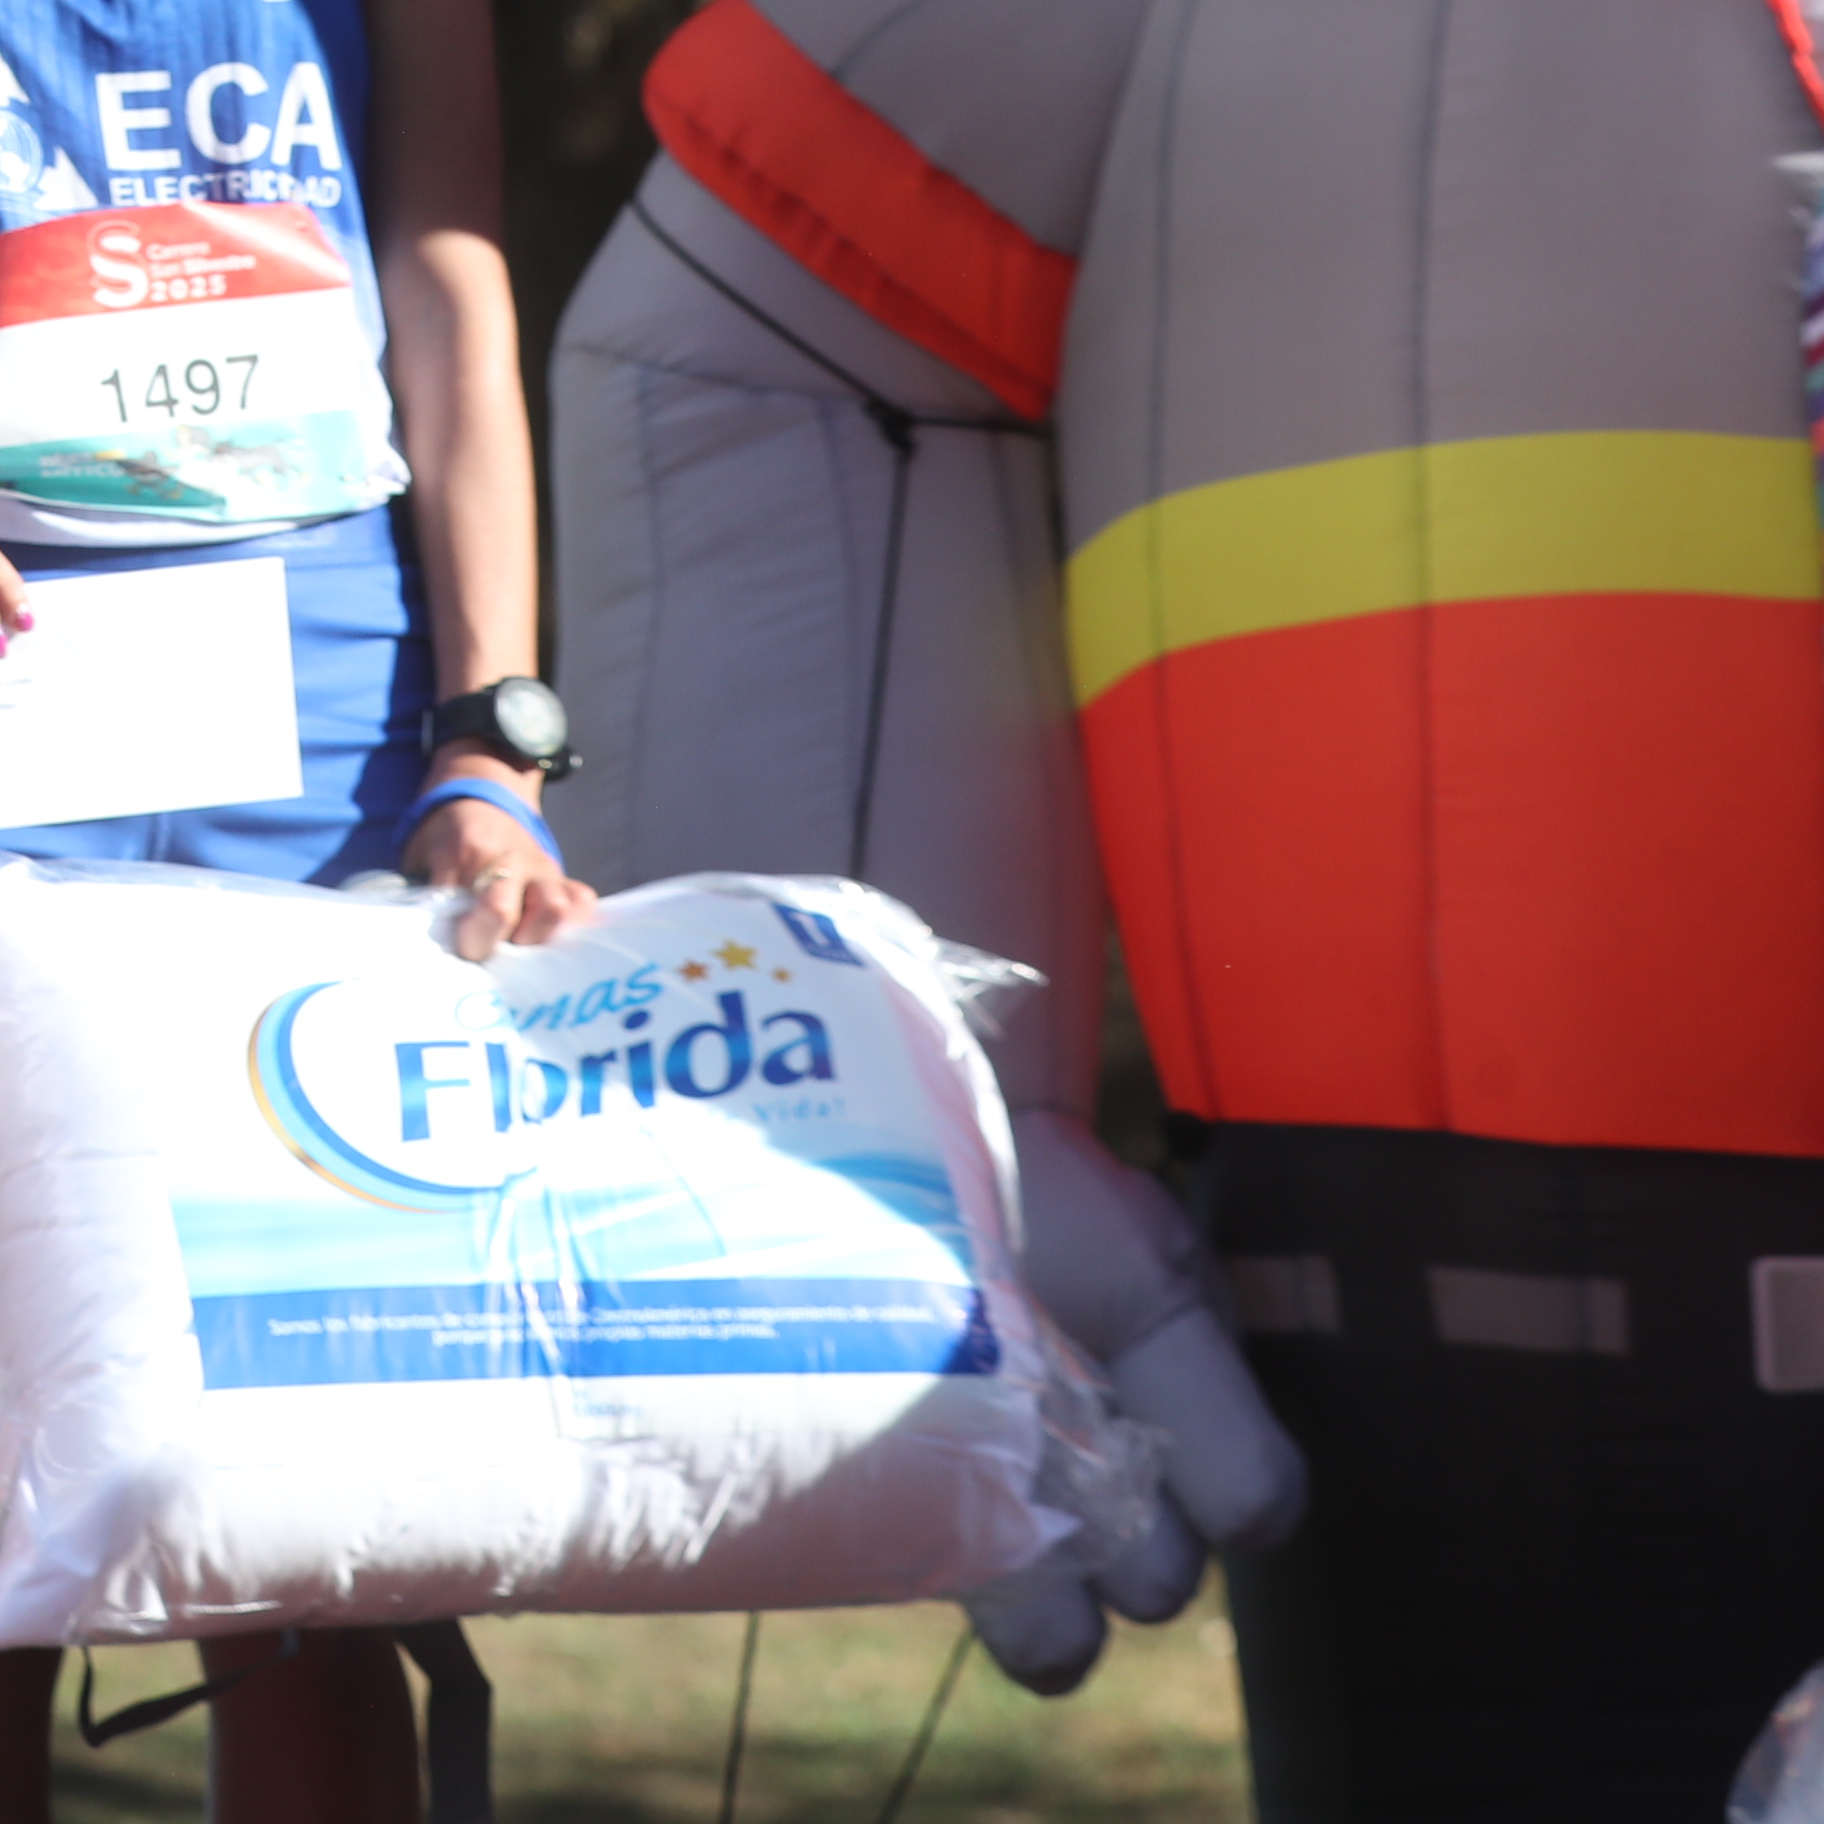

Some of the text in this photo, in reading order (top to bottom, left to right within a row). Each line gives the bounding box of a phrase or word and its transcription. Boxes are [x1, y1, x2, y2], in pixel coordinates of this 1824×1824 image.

[94, 61, 342, 172] ECA
[100, 354, 261, 424] 1497
[394, 988, 838, 1144] Florida
